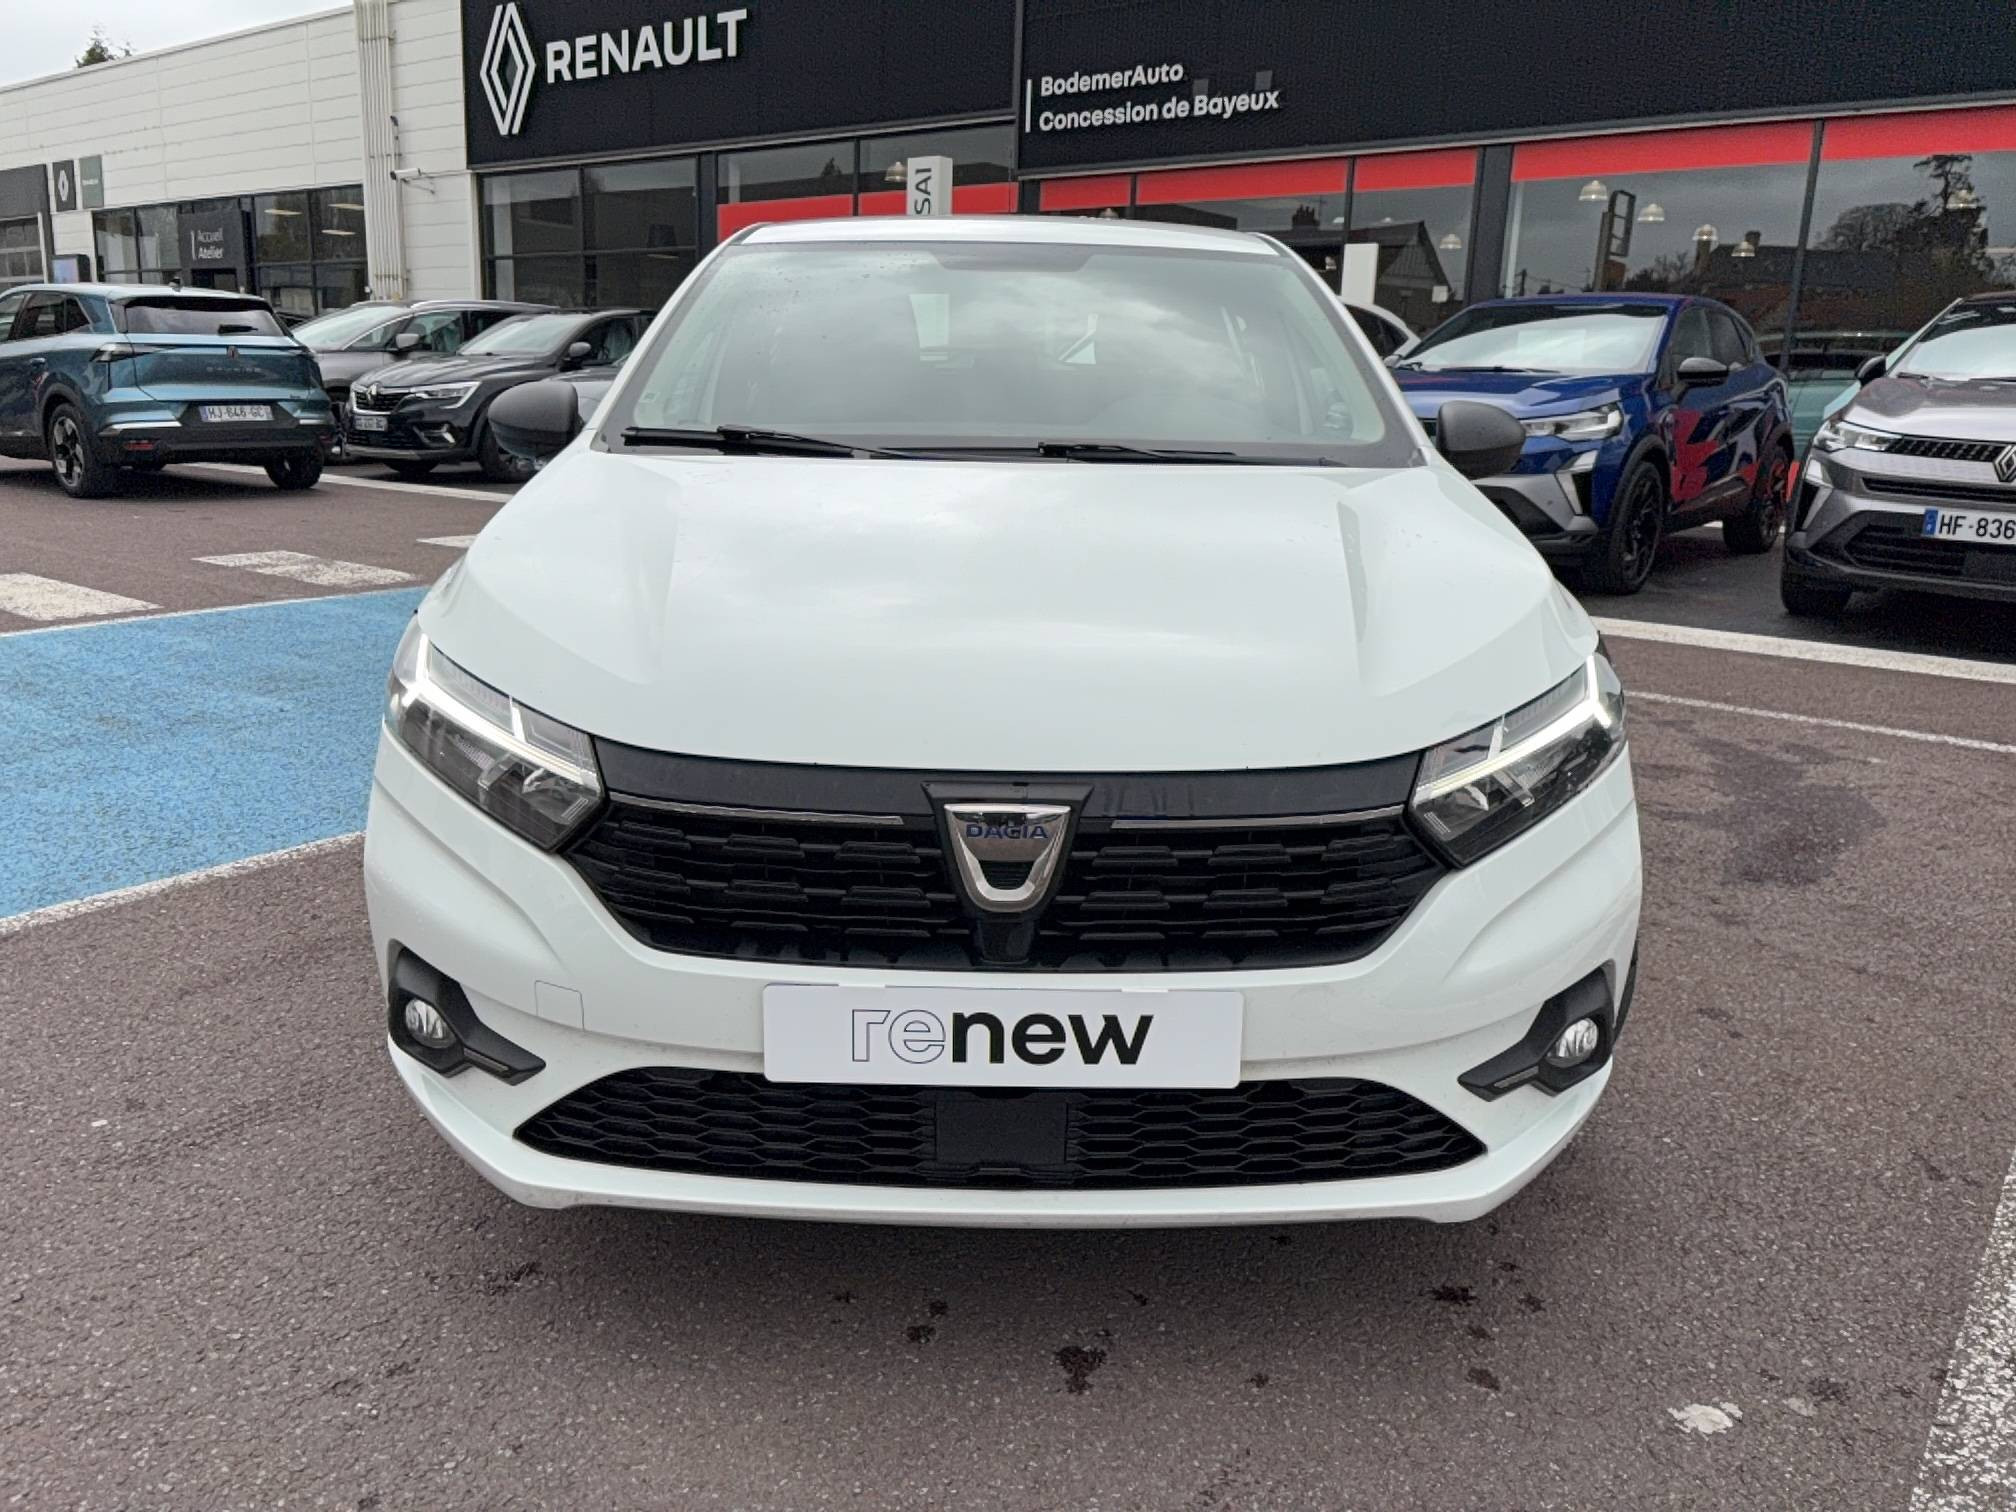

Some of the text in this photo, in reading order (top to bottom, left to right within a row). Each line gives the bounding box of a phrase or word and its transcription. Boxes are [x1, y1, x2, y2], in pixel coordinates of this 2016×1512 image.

[546, 8, 748, 84] RENAULT
[1040, 63, 1184, 97] BodemerAuto
[1039, 90, 1281, 132] Concession de Bayeux
[198, 246, 224, 259] Atelier
[852, 1009, 1154, 1066] renew
